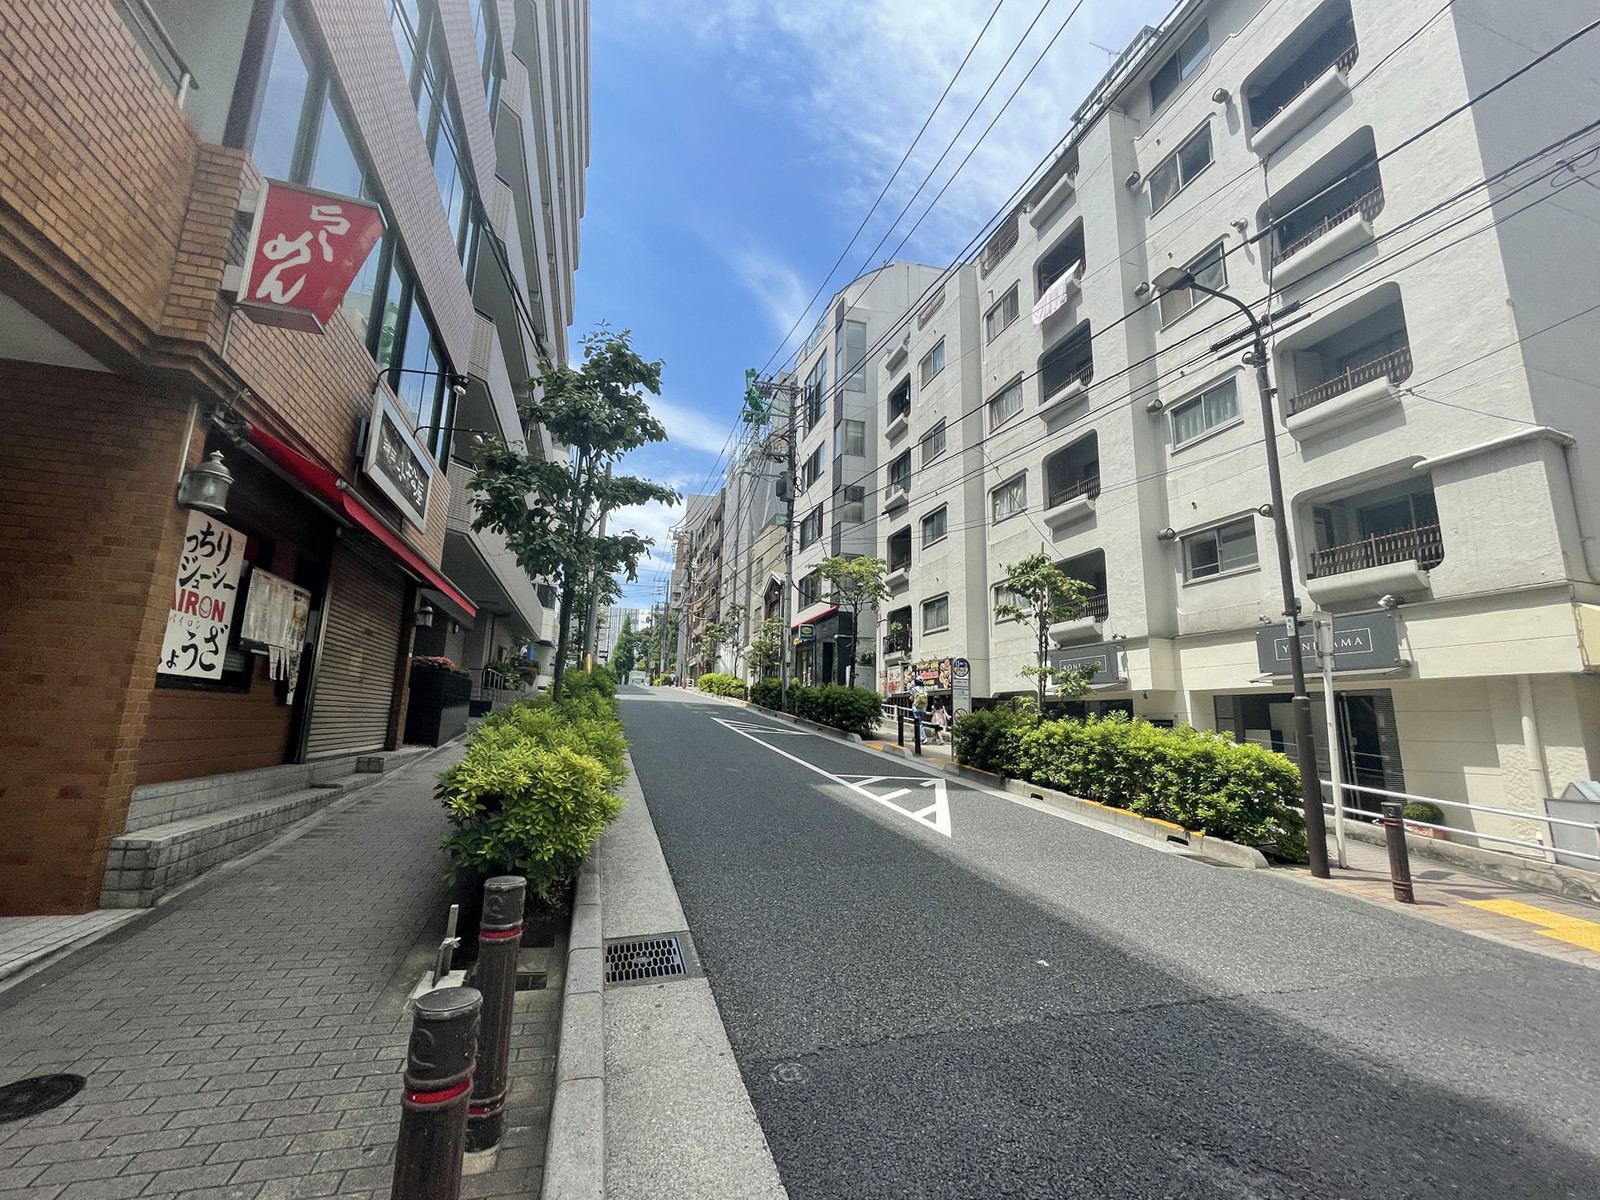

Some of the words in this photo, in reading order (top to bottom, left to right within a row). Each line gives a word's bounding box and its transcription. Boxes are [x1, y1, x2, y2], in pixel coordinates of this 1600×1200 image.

[179, 555, 236, 591] ジューシー
